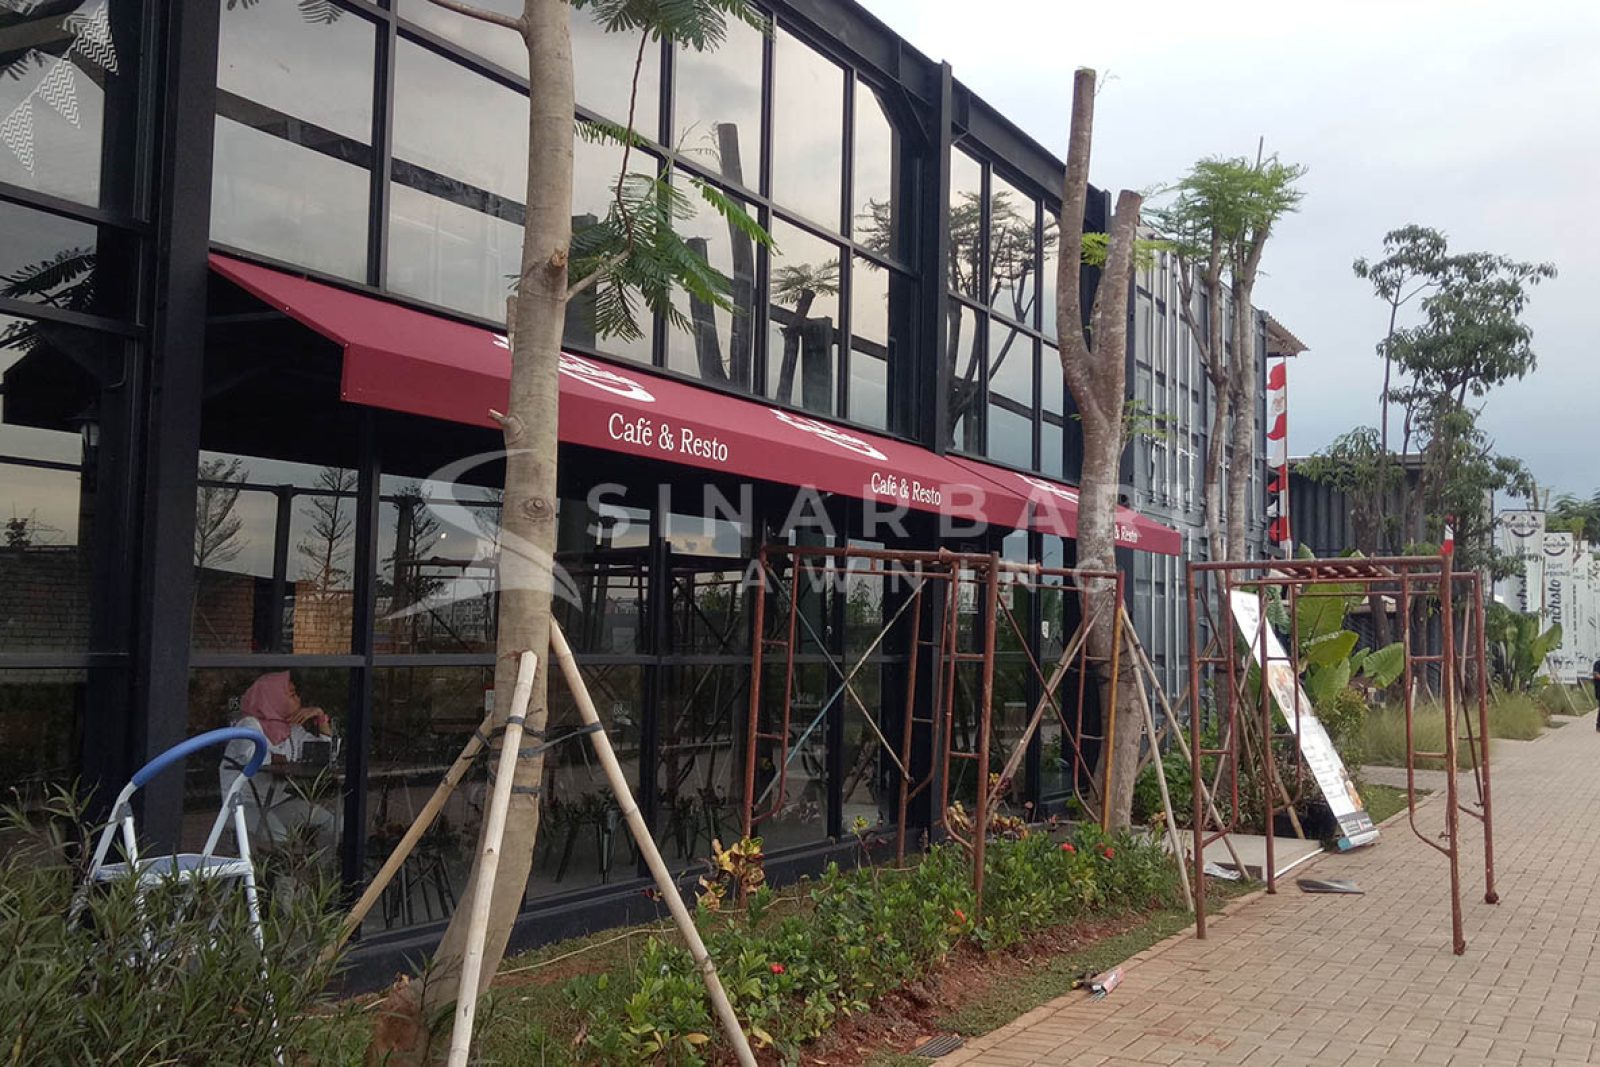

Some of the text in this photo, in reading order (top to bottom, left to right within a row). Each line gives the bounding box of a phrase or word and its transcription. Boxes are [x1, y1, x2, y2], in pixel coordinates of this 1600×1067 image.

[608, 412, 653, 446] Café
[658, 423, 674, 451] &
[679, 428, 729, 462] Resto
[871, 472, 942, 507] Café & Resto
[1120, 525, 1138, 543] Resto
